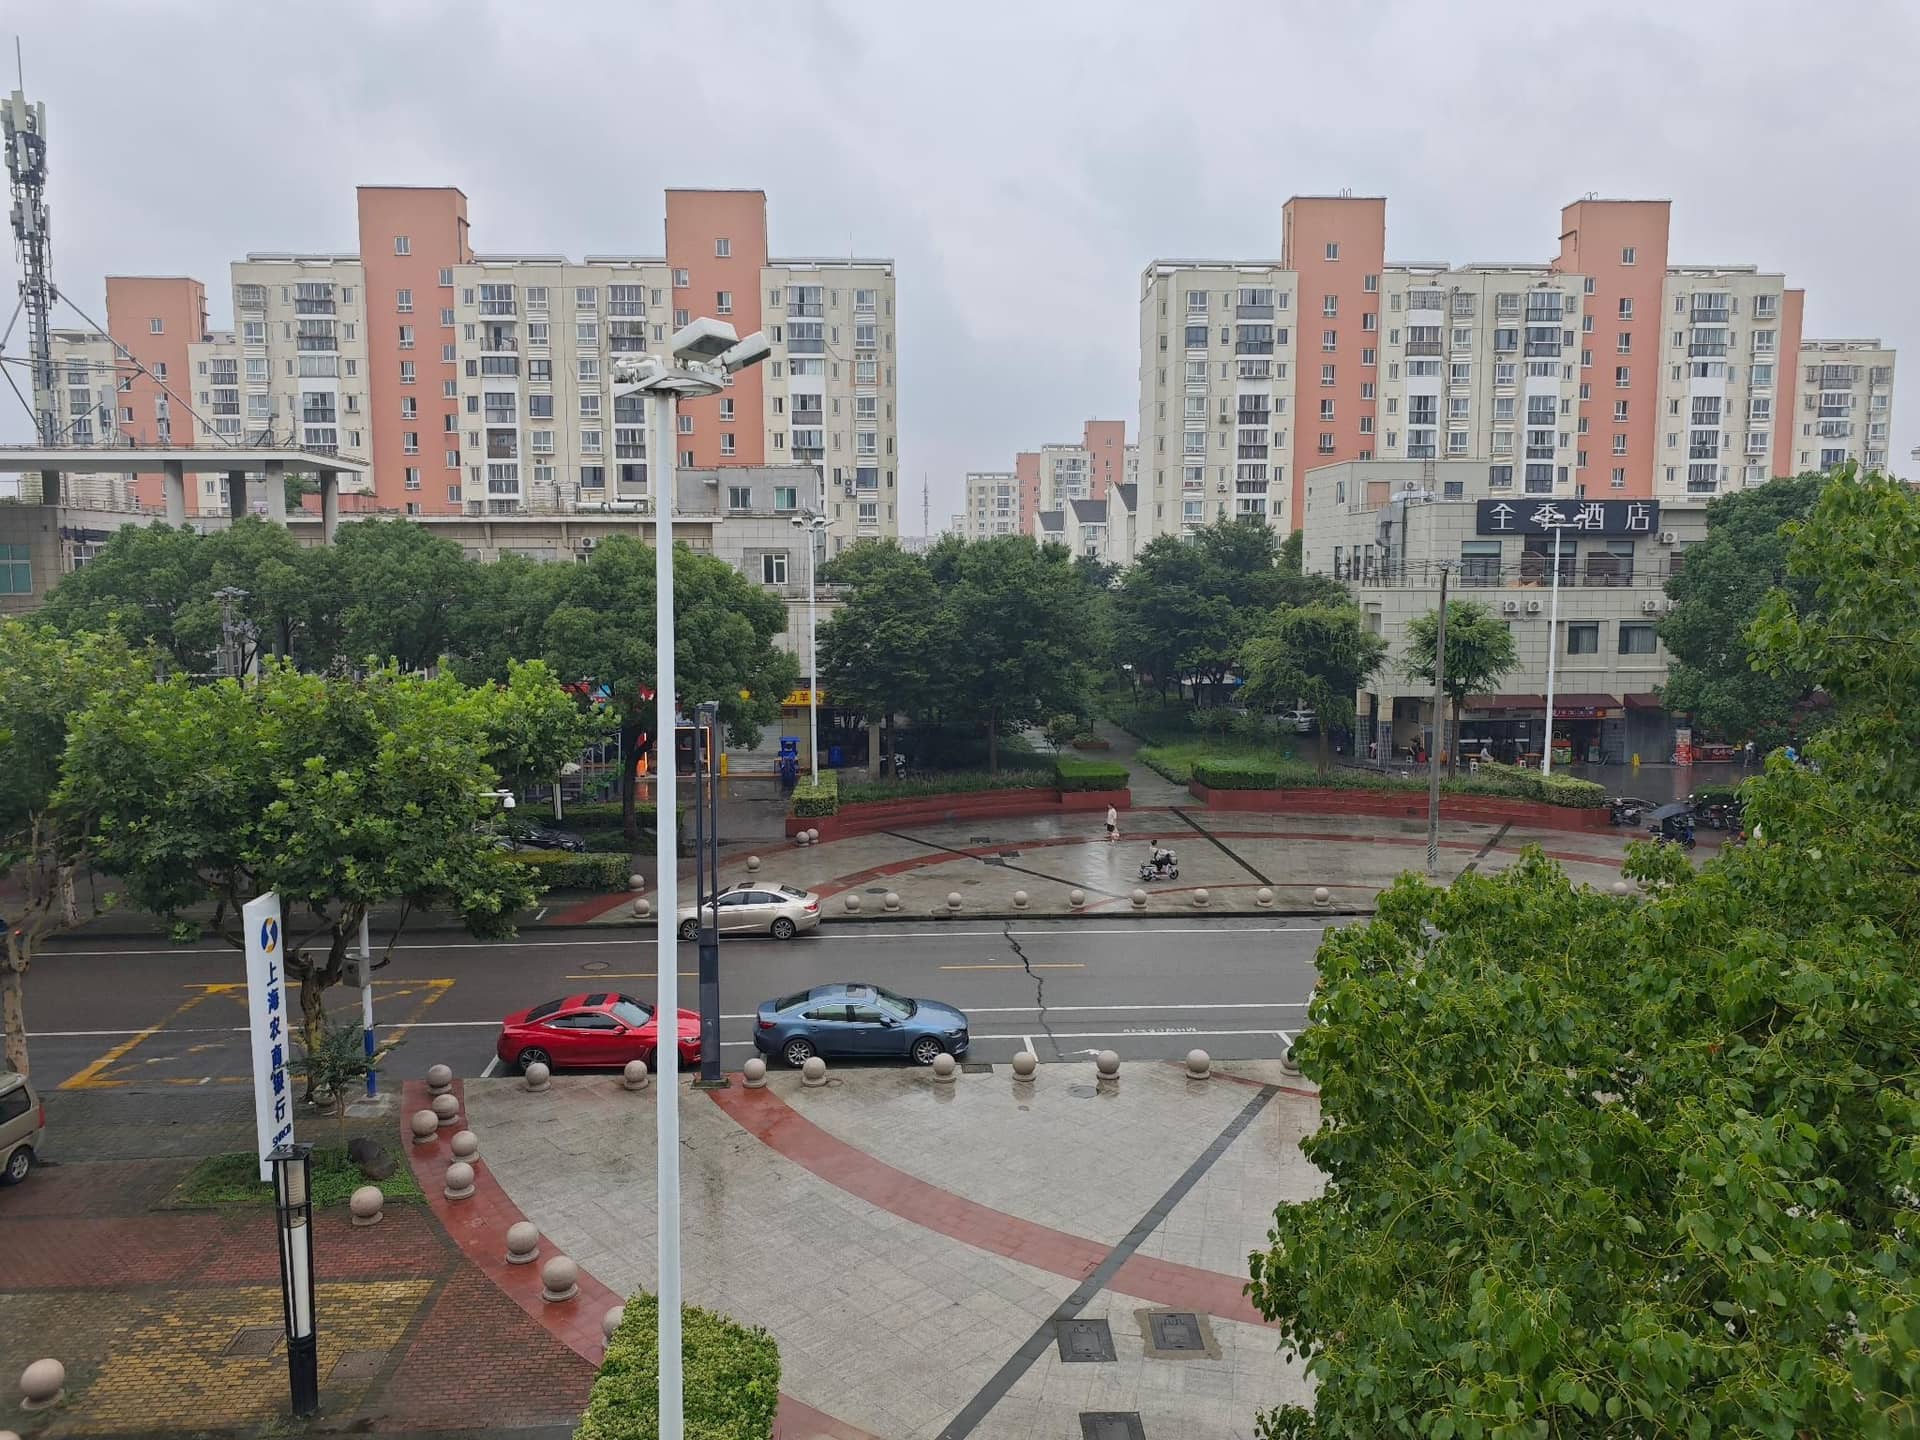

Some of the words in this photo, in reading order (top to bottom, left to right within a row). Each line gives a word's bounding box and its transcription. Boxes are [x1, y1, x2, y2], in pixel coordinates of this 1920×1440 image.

[1489, 502, 1651, 531] 全季酒店
[267, 961, 286, 1123] 上海农商银行
